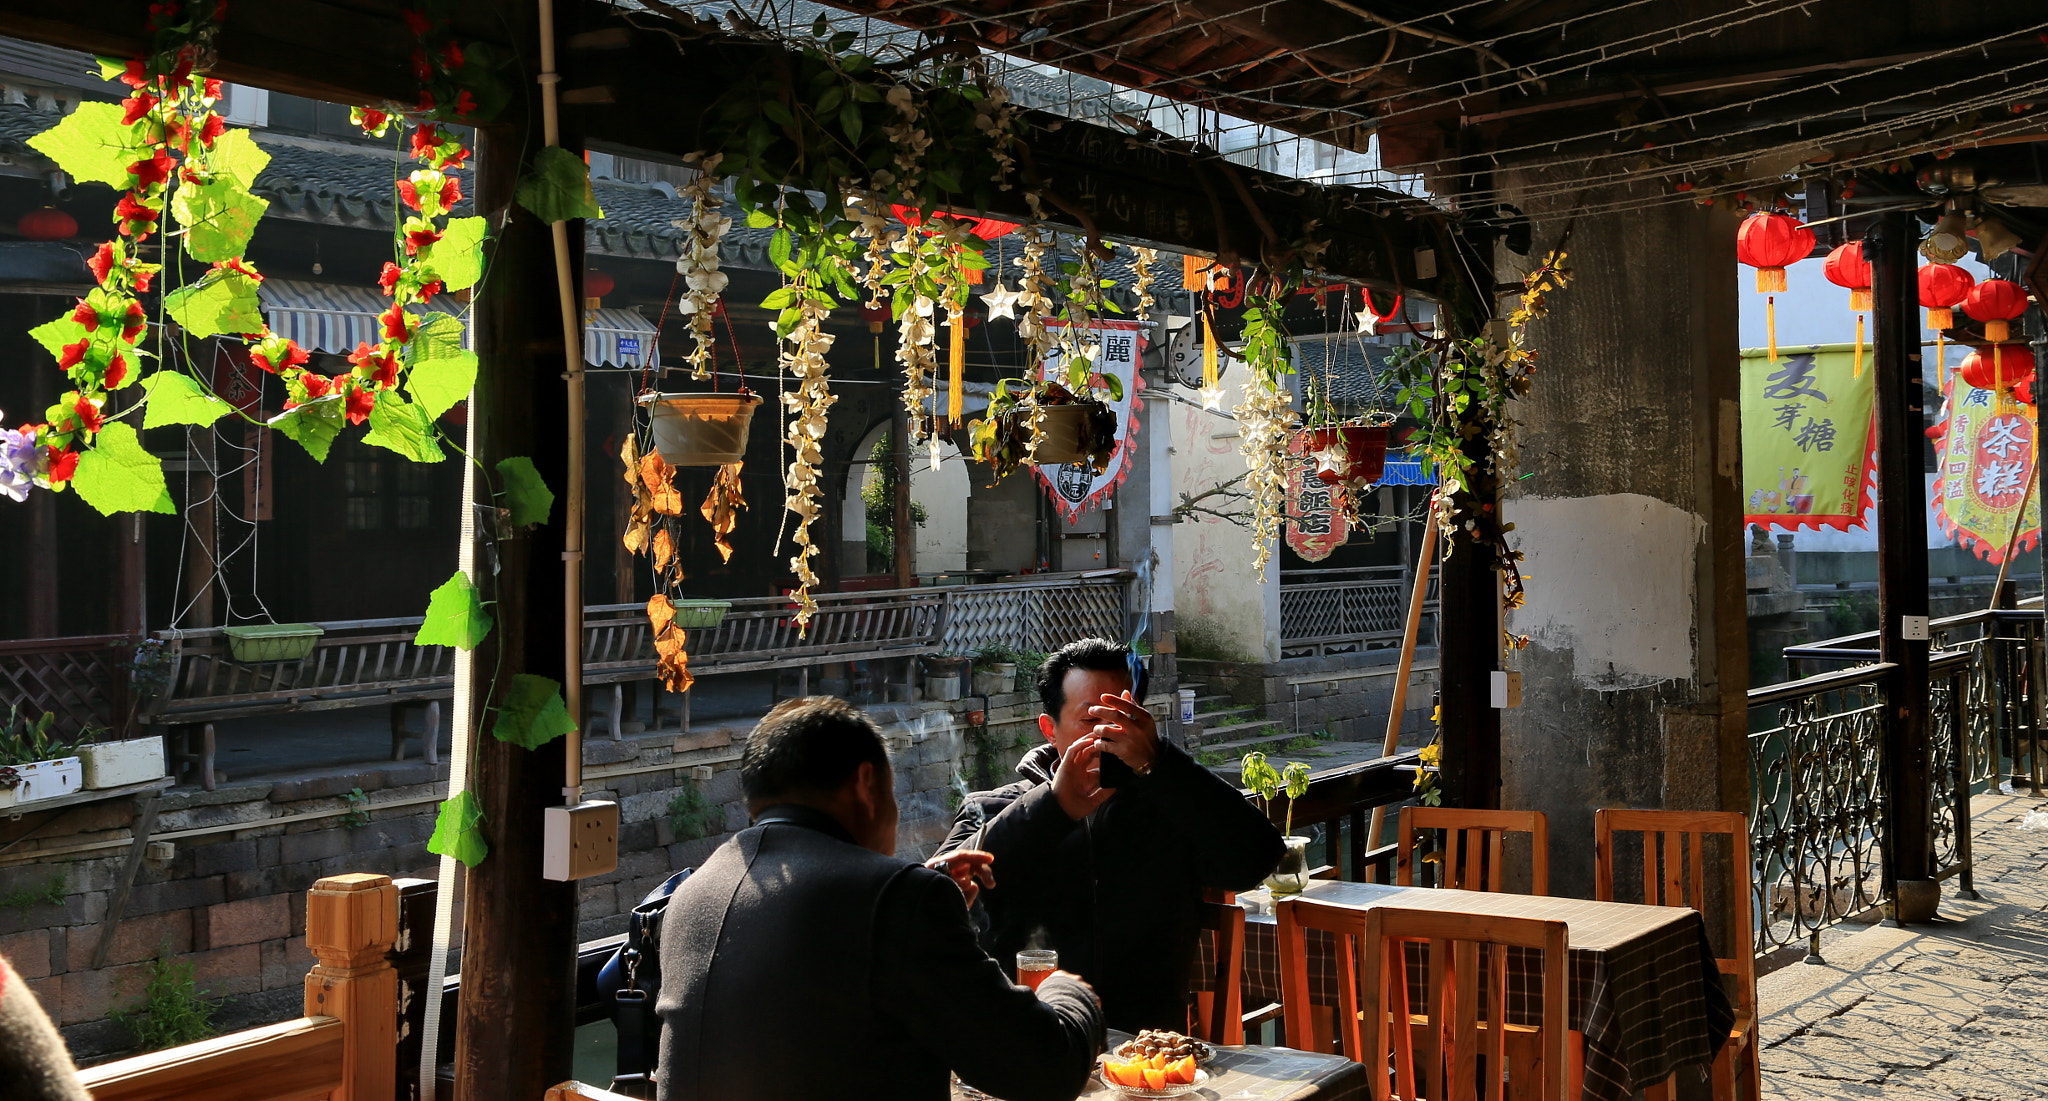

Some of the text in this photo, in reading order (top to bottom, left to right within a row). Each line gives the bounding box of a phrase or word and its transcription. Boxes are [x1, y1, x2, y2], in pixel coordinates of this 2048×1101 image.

[224, 363, 252, 402] 茶
[1174, 352, 1185, 362] 9
[1763, 353, 1837, 453] 麦芽糖
[1977, 416, 2030, 498] 茶糕
